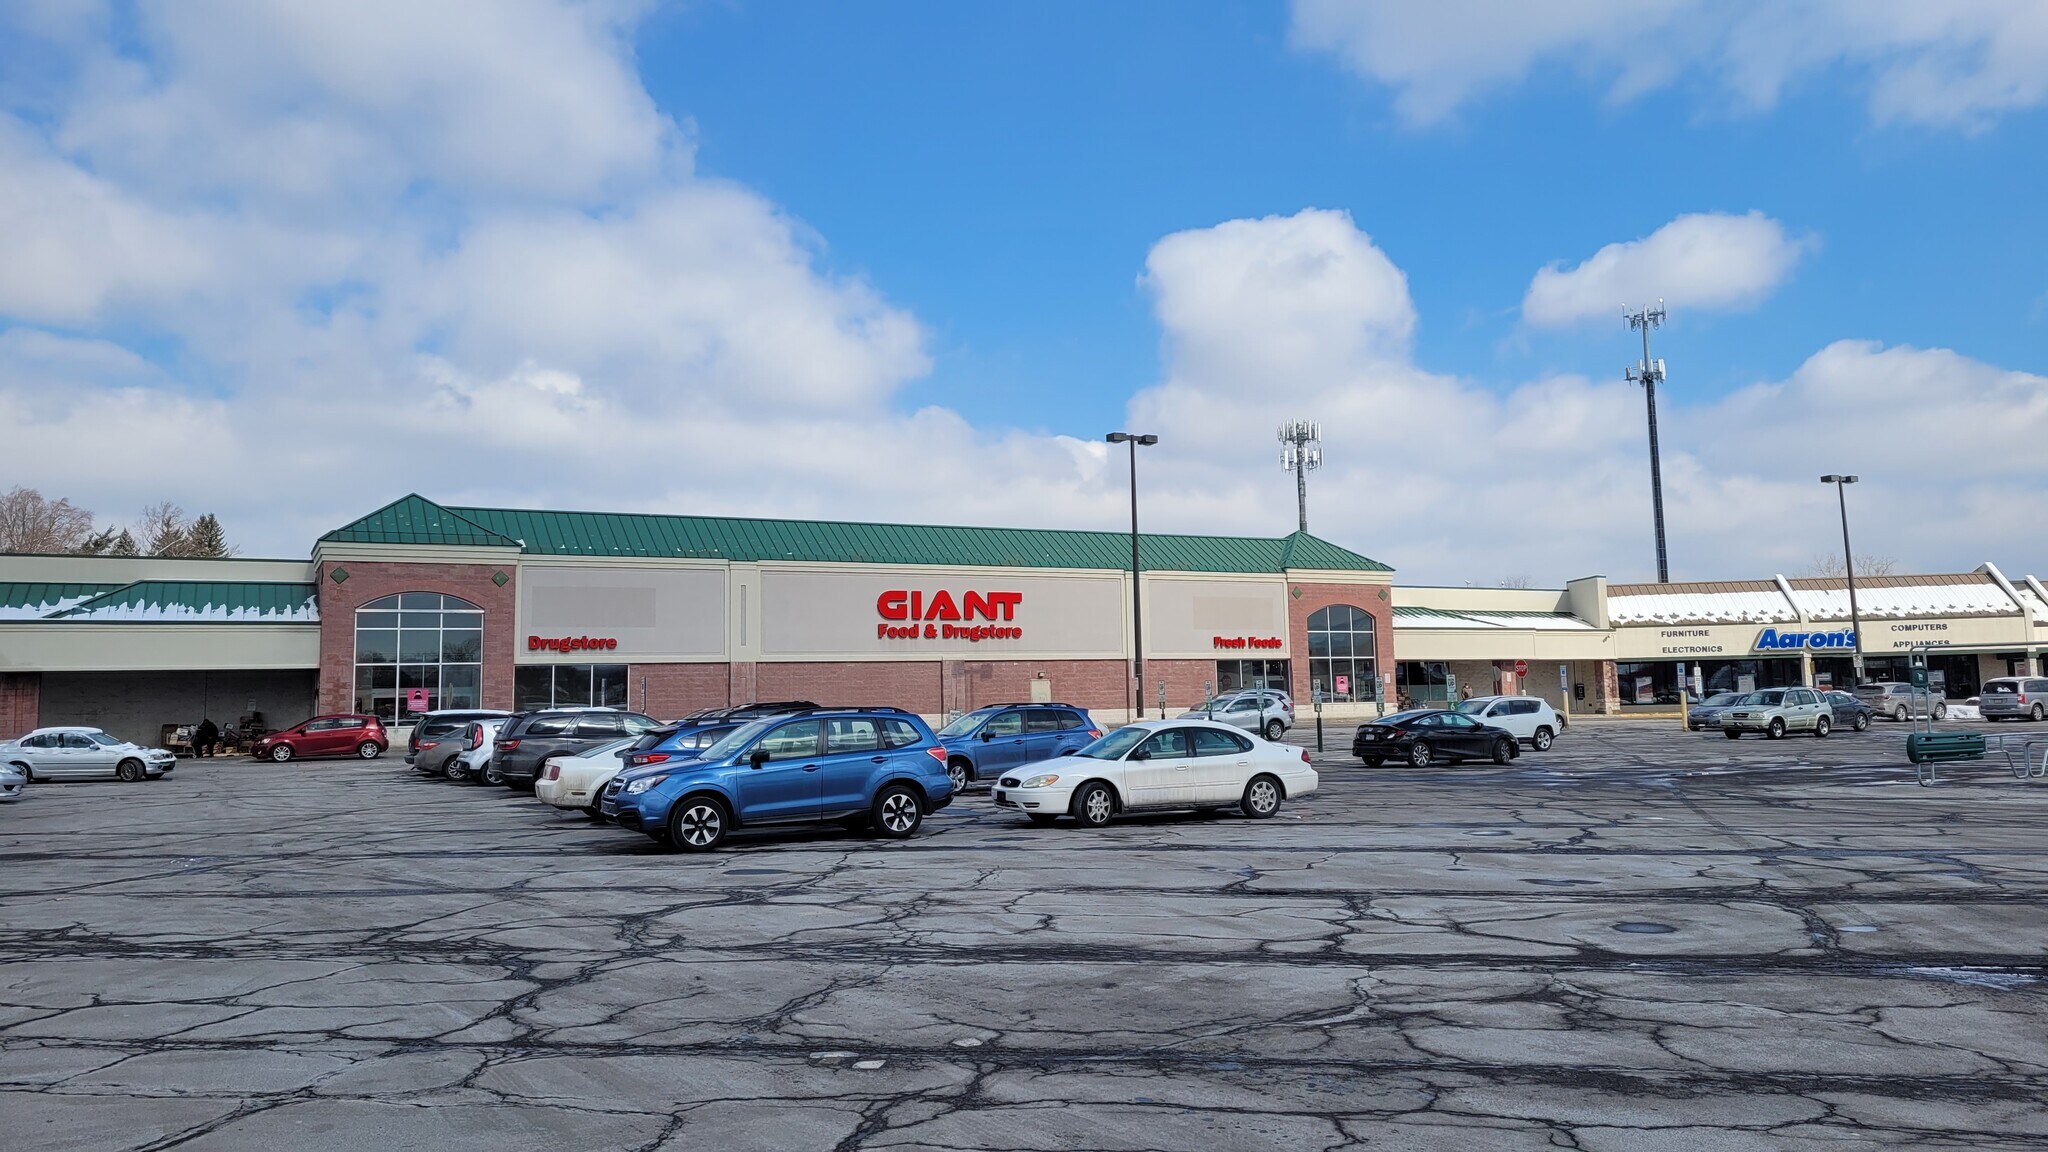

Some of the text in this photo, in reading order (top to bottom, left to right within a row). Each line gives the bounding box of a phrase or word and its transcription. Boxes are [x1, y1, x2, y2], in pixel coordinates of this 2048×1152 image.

[877, 590, 1022, 621] GIANT
[1891, 623, 1948, 632] COMPUTERS
[878, 624, 1022, 642] Food & Drugstore
[1661, 630, 1710, 638] FURNITURE
[1213, 636, 1282, 649] Fresh Foods
[1755, 628, 1856, 650] Aaron's
[528, 635, 617, 653] Drugstore
[1662, 646, 1723, 654] ELECTRONICS
[1515, 664, 1527, 672] STOP
[1378, 703, 1383, 711] 5
[1450, 702, 1455, 711] 6
